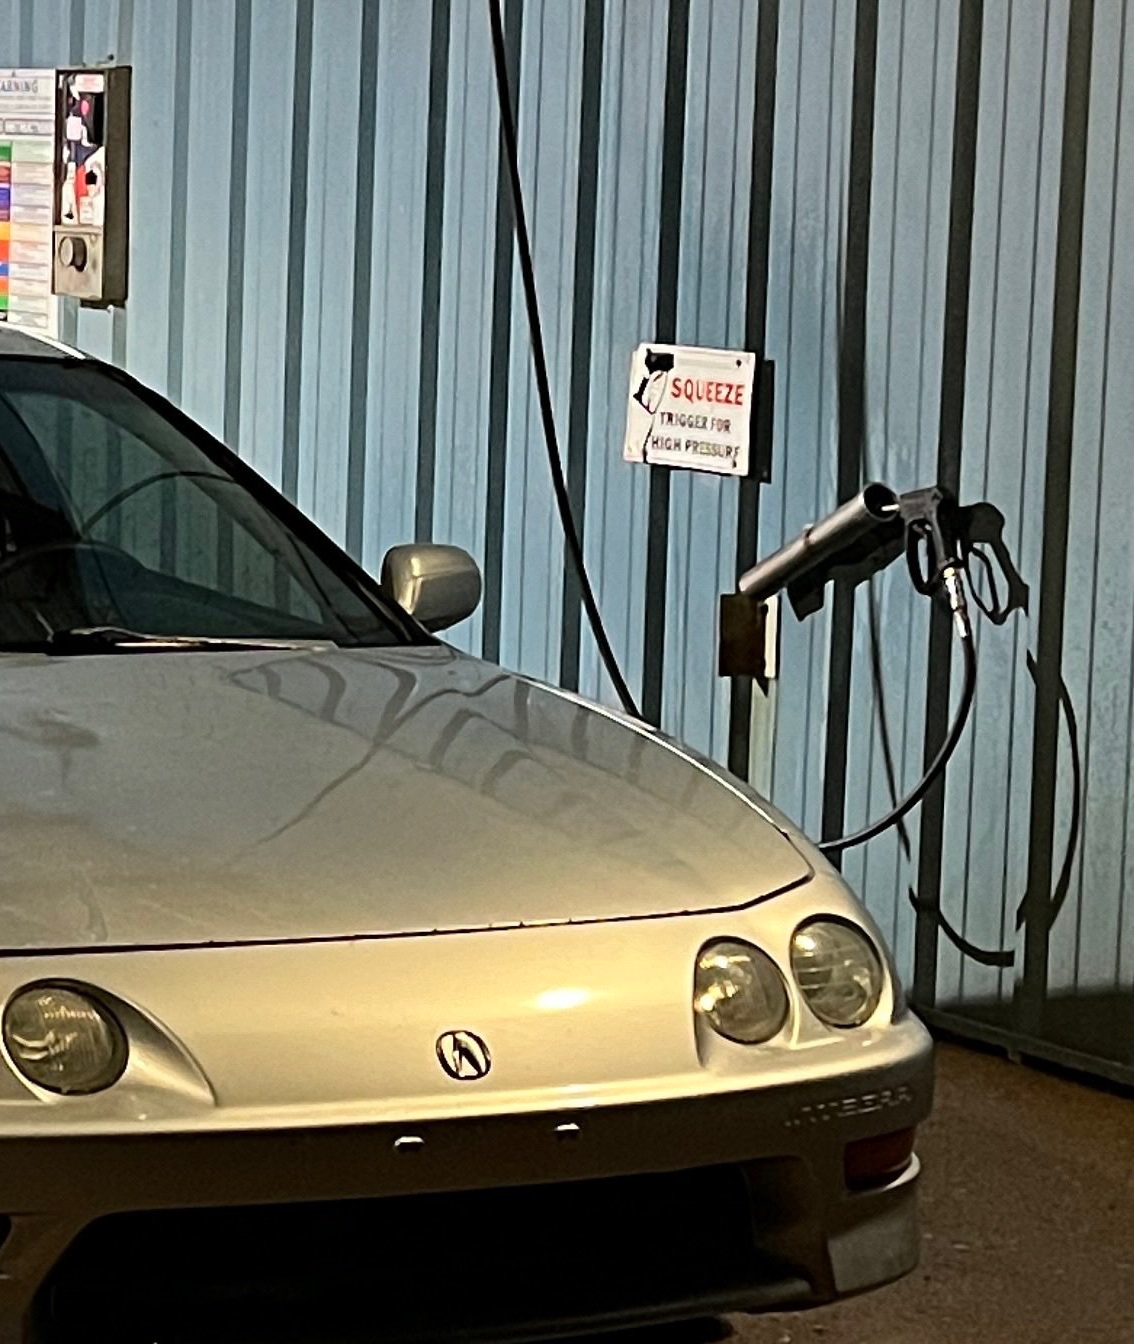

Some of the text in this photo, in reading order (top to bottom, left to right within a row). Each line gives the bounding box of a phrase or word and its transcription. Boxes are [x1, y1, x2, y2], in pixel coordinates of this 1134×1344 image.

[671, 377, 745, 406] SQUEEZE
[660, 411, 732, 433] TRIGGER FOR
[651, 436, 740, 458] HIGH PRESSURE
